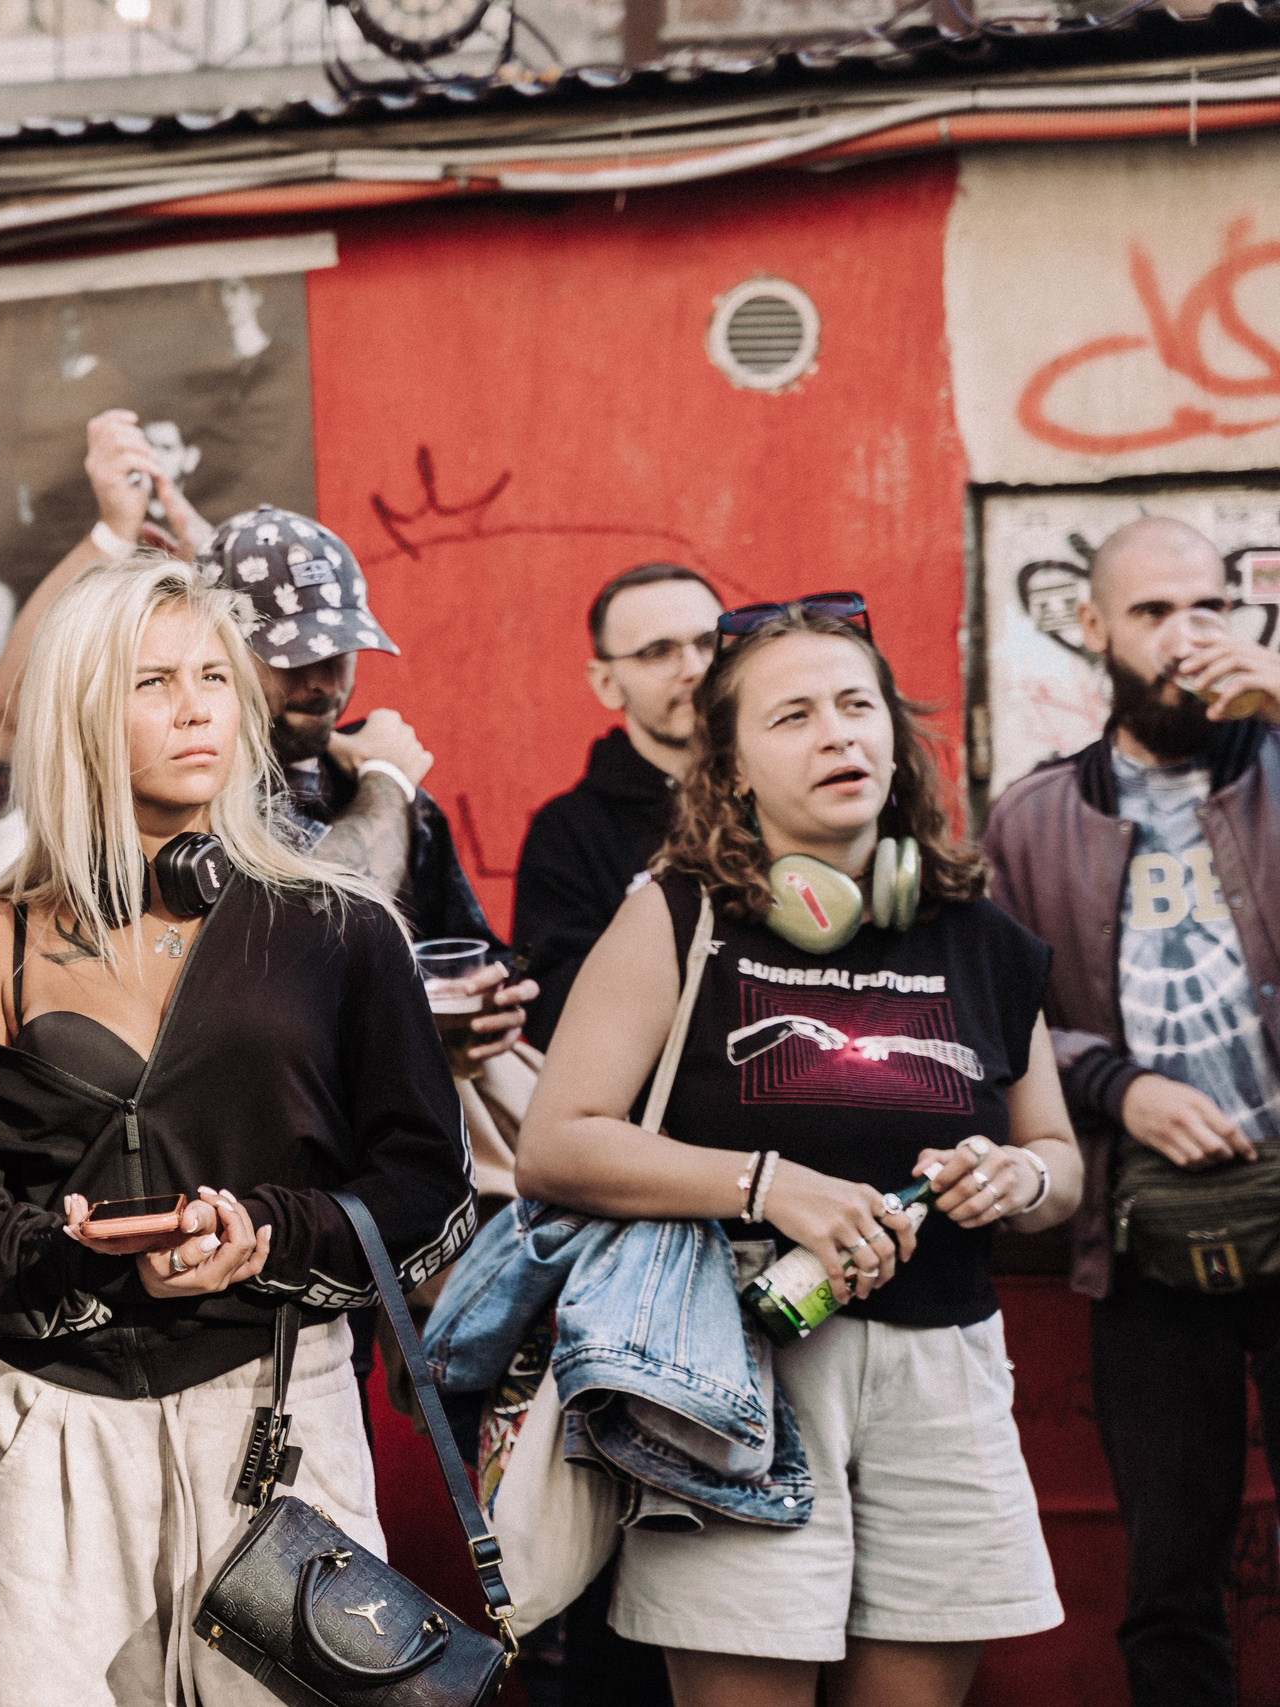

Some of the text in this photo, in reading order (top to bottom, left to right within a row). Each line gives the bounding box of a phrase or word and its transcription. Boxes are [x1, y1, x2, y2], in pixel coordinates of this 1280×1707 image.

[737, 957, 946, 994] SURREAL FUTURE
[410, 1202, 476, 1288] GUESS
[301, 1283, 380, 1309] UESS
